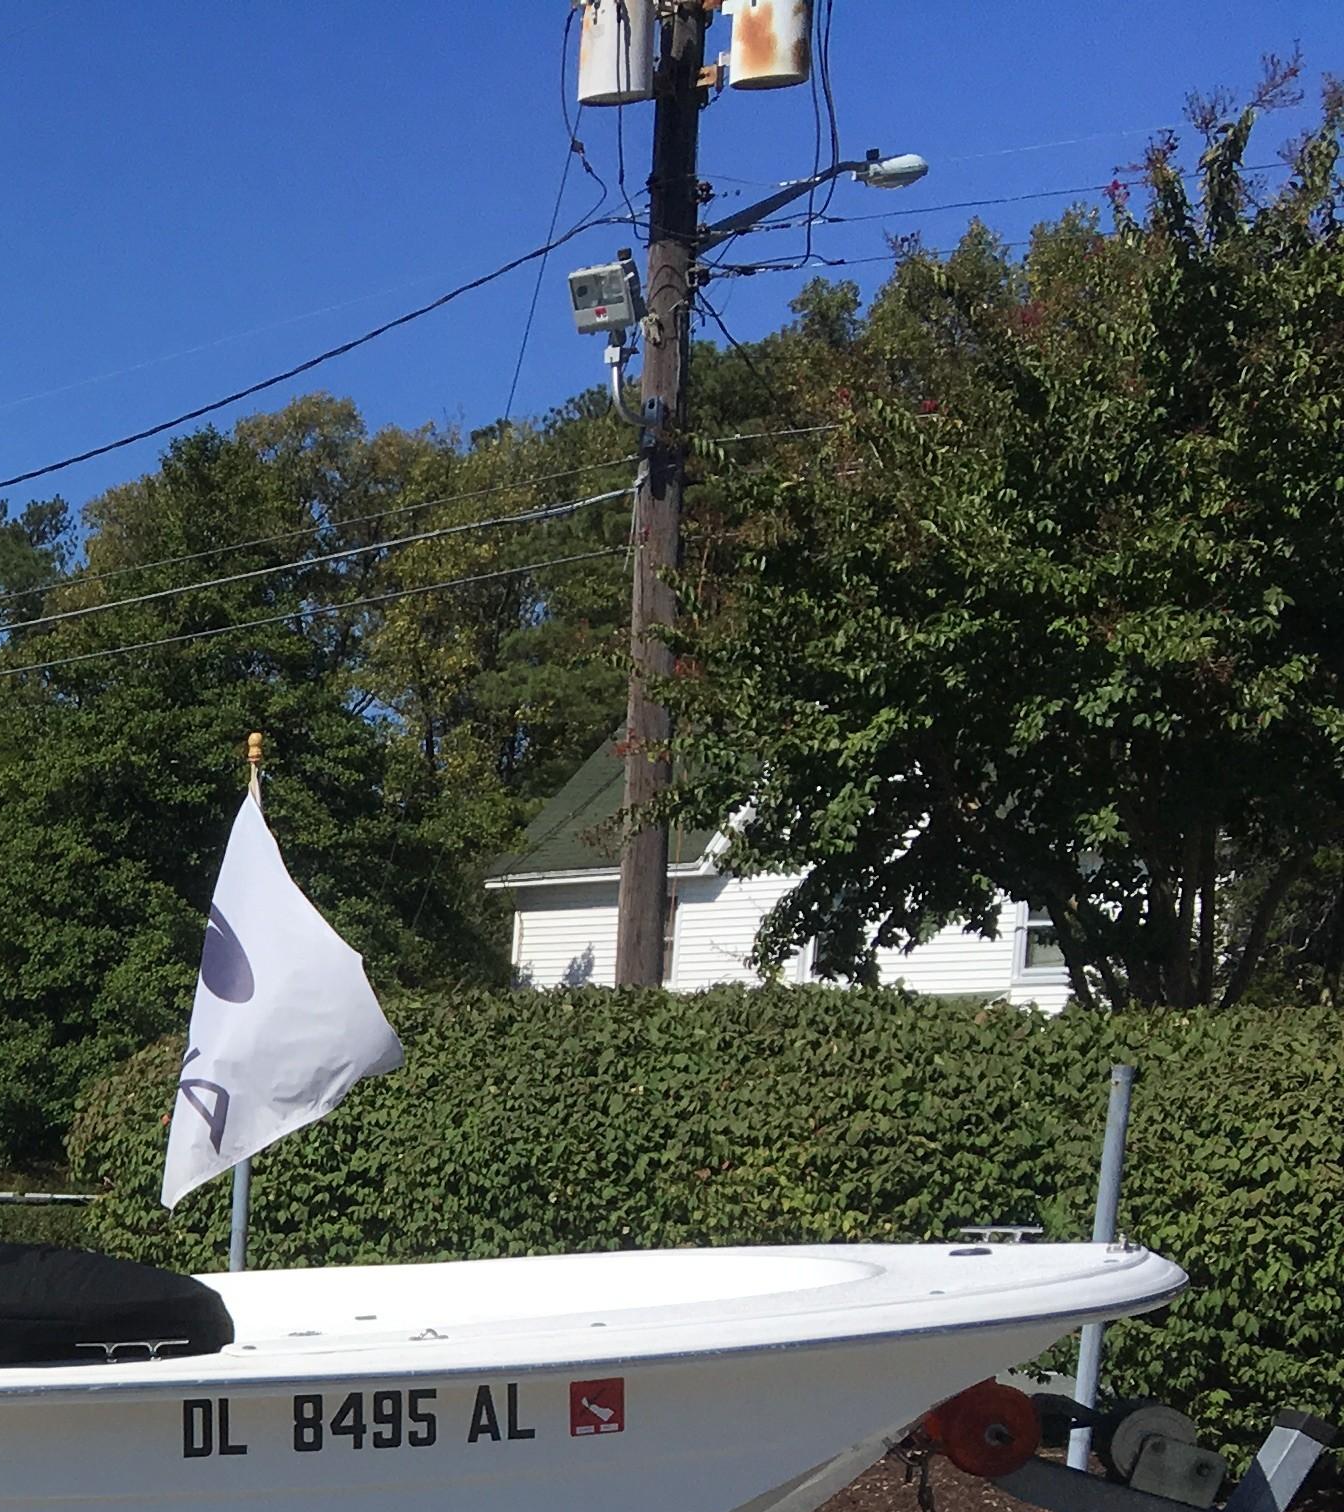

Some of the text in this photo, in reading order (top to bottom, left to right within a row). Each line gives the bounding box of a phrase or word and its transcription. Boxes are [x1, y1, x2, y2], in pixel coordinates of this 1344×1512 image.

[182, 1382, 535, 1458] DL 8495 AL
